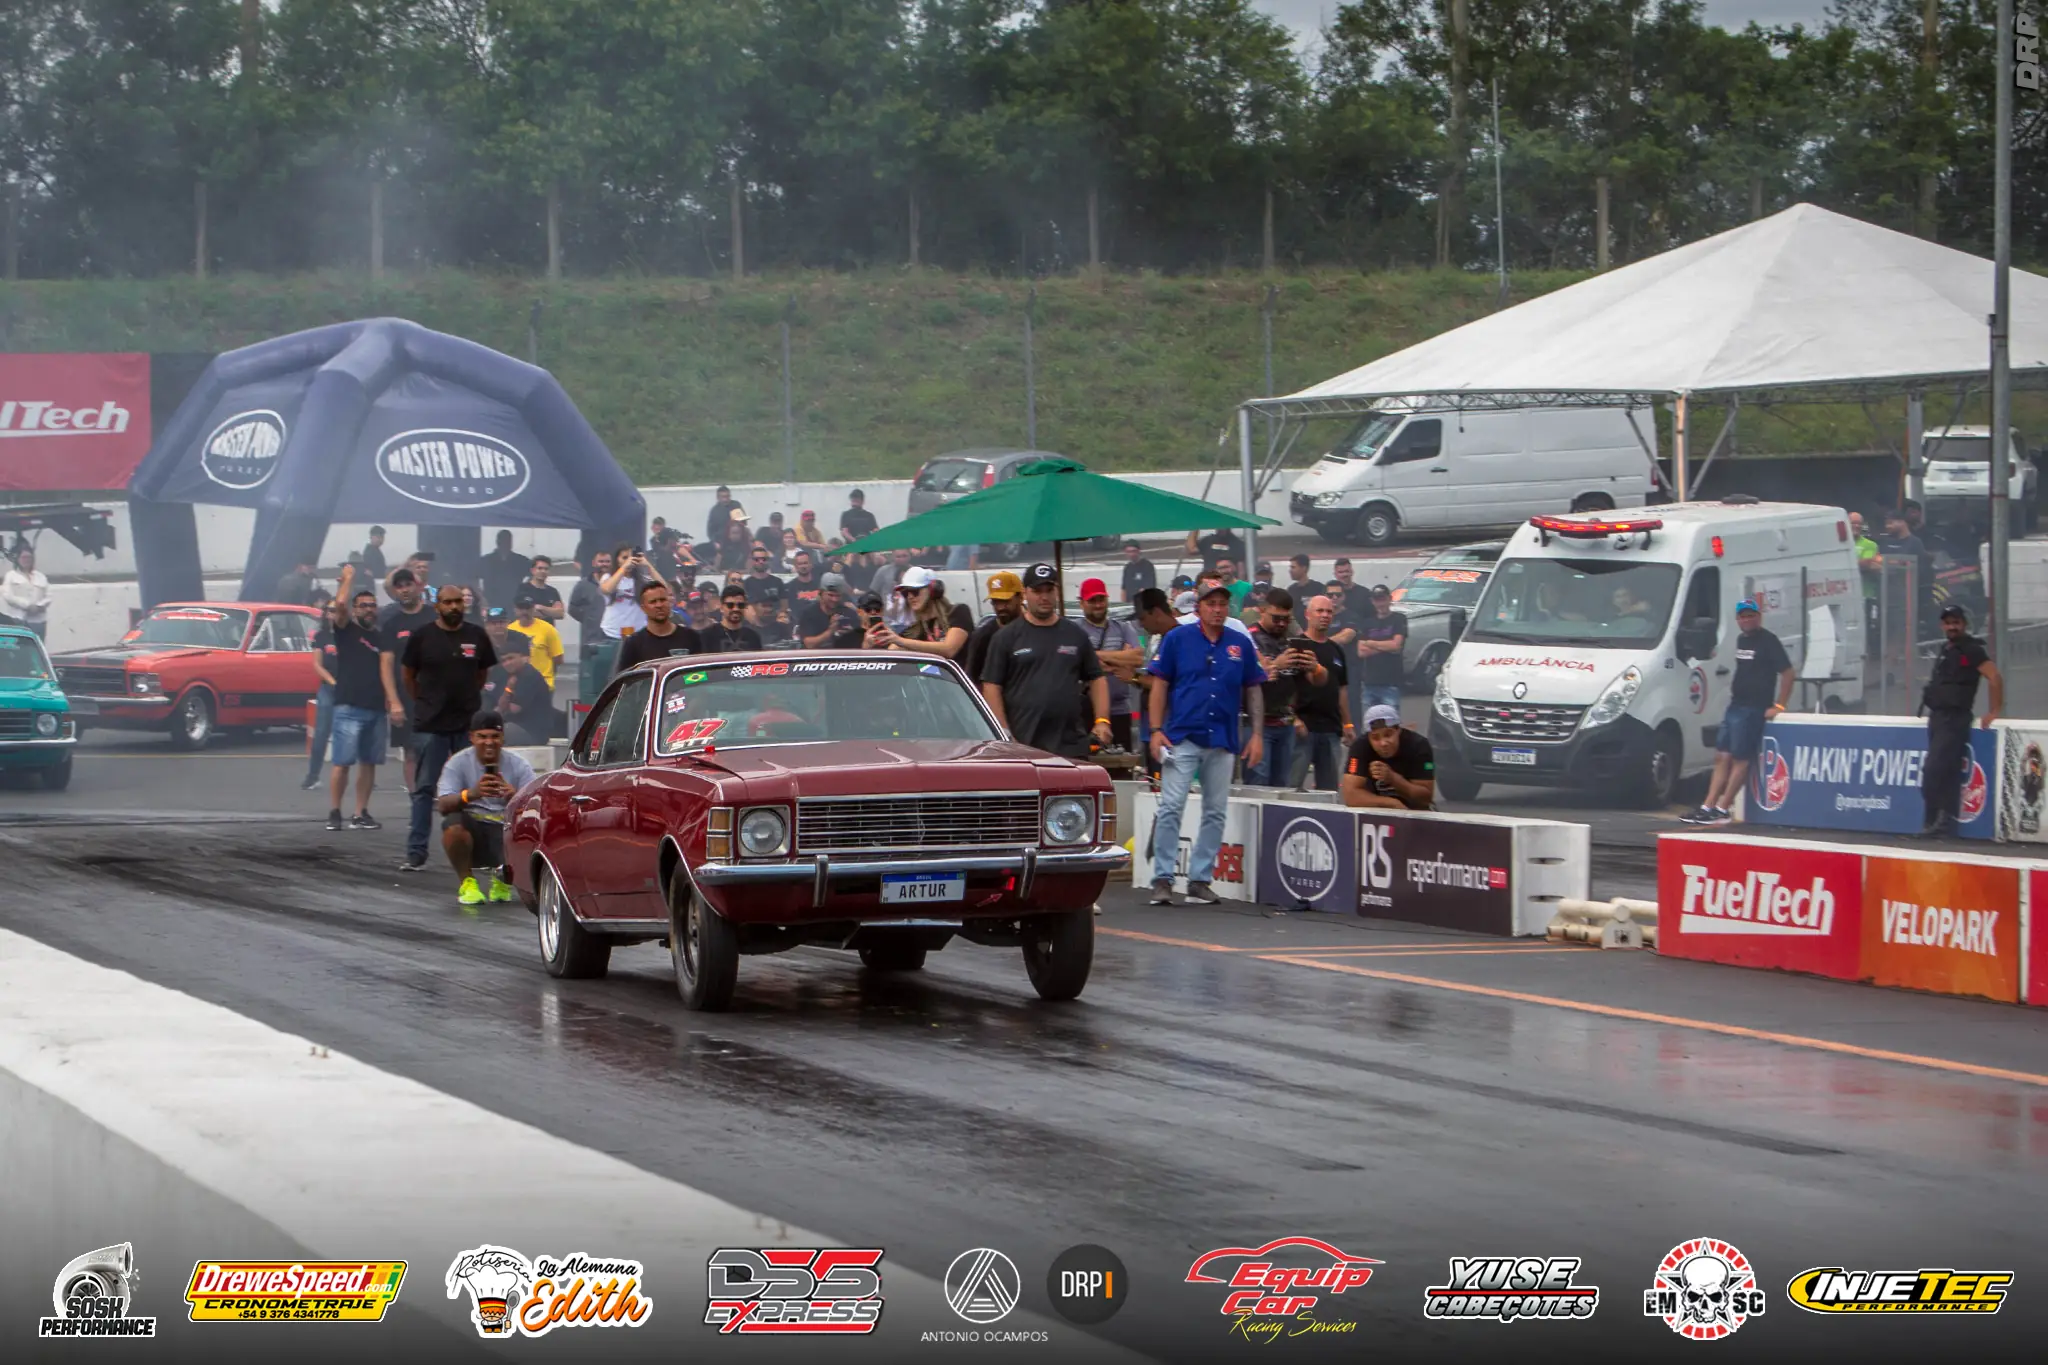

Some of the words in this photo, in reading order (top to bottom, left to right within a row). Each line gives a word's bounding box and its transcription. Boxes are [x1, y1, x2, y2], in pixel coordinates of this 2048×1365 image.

[388, 441, 455, 478] MASTER
[453, 441, 517, 478] POWER
[420, 485, 494, 495] TURBO
[750, 663, 789, 677] RC
[793, 662, 897, 672] MOTORSPORT
[1474, 656, 1596, 673] AMBULÂNCIA
[664, 718, 728, 743] 47
[1793, 746, 1859, 783] MAKIN'
[1362, 823, 1395, 889] RS
[899, 883, 946, 898] ARTUR
[1290, 876, 1321, 889] TURBO
[1682, 864, 1835, 934] FuelTech
[1882, 899, 1998, 956] VELOPARK
